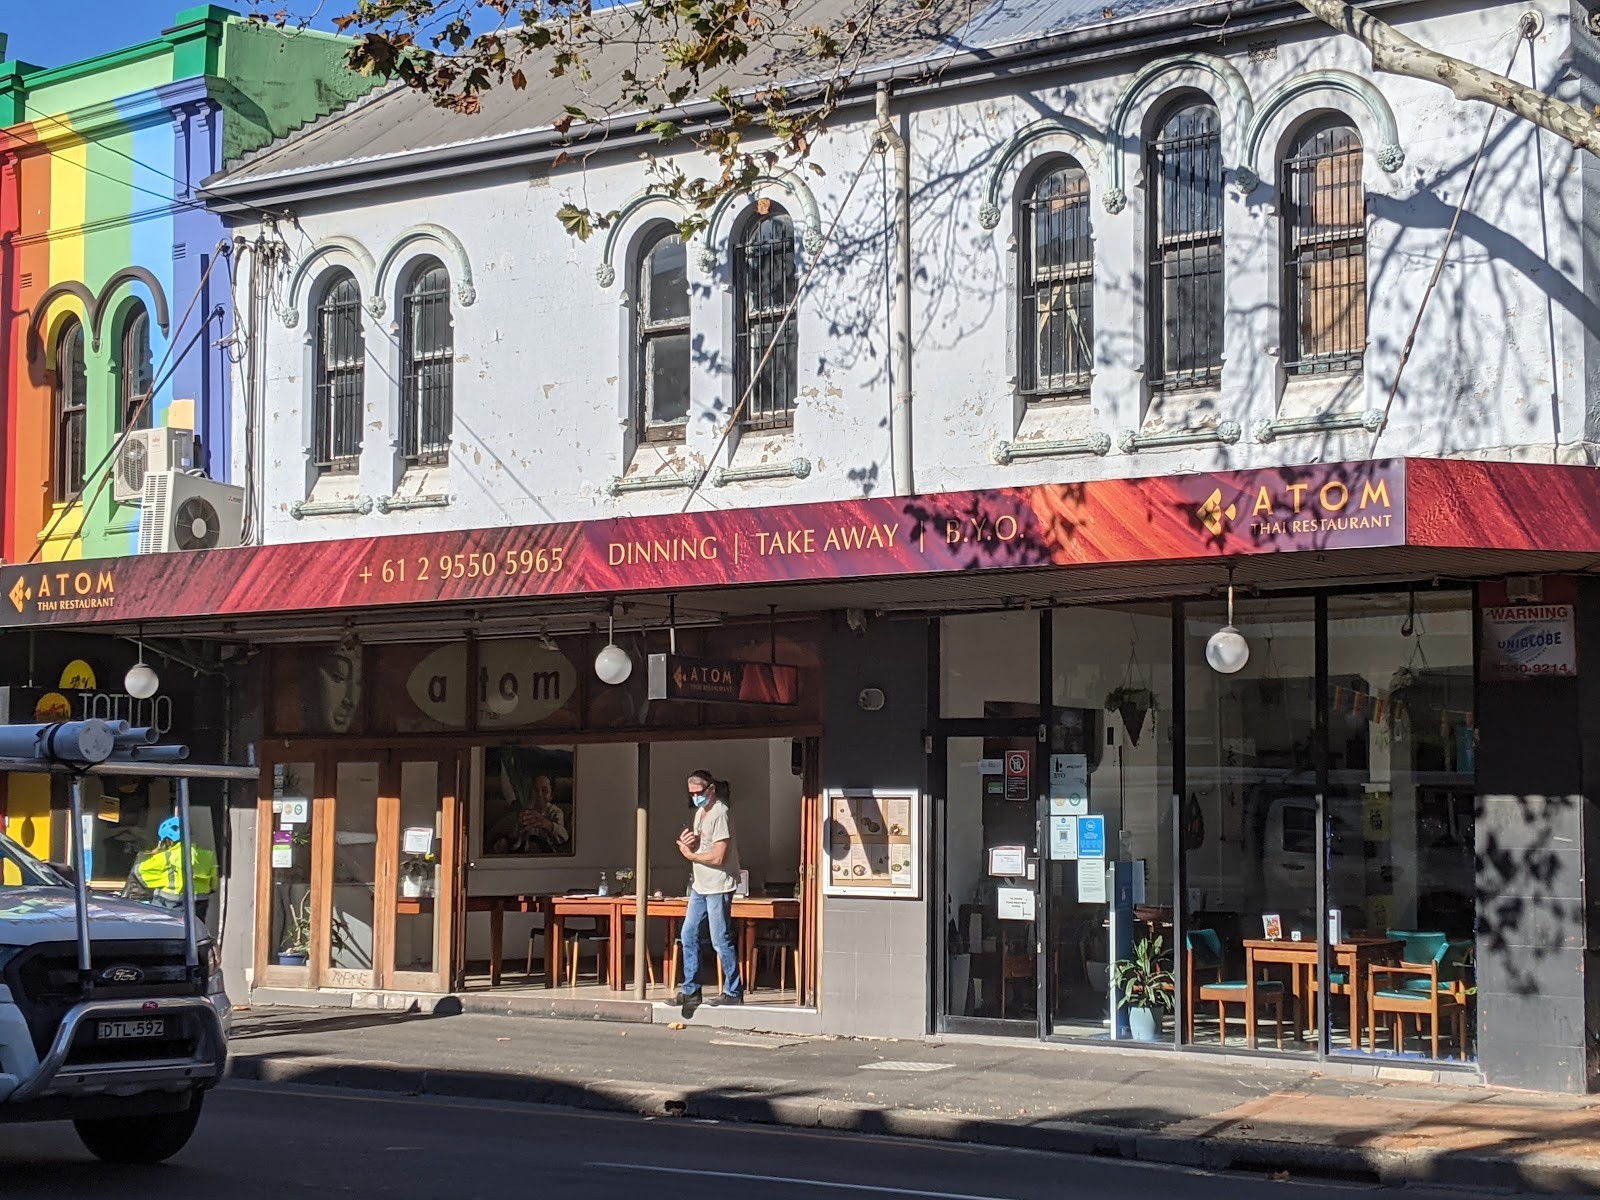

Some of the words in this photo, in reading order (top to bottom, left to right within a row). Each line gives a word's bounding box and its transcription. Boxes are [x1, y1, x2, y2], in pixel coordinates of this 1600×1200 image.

[1252, 478, 1391, 516] ATOM
[1251, 521, 1287, 535] THAI
[1292, 515, 1392, 533] RESTAURANT
[609, 536, 718, 566] DINNING
[755, 529, 815, 556] TAKE
[823, 523, 899, 551] AWAY
[946, 515, 1025, 544] B.Y.O.
[381, 558, 406, 583] 61
[417, 557, 429, 581] 2
[439, 552, 497, 579] 9550
[505, 547, 564, 575] 5965
[38, 571, 114, 597] ATOM
[37, 602, 57, 611] THAI
[60, 598, 115, 610] RESTAURANT
[1490, 607, 1568, 619] WARNING
[1498, 632, 1562, 649] UNIGLOBE
[428, 666, 561, 703] atom
[691, 667, 732, 684] ATOM
[113, 969, 138, 981] Ford
